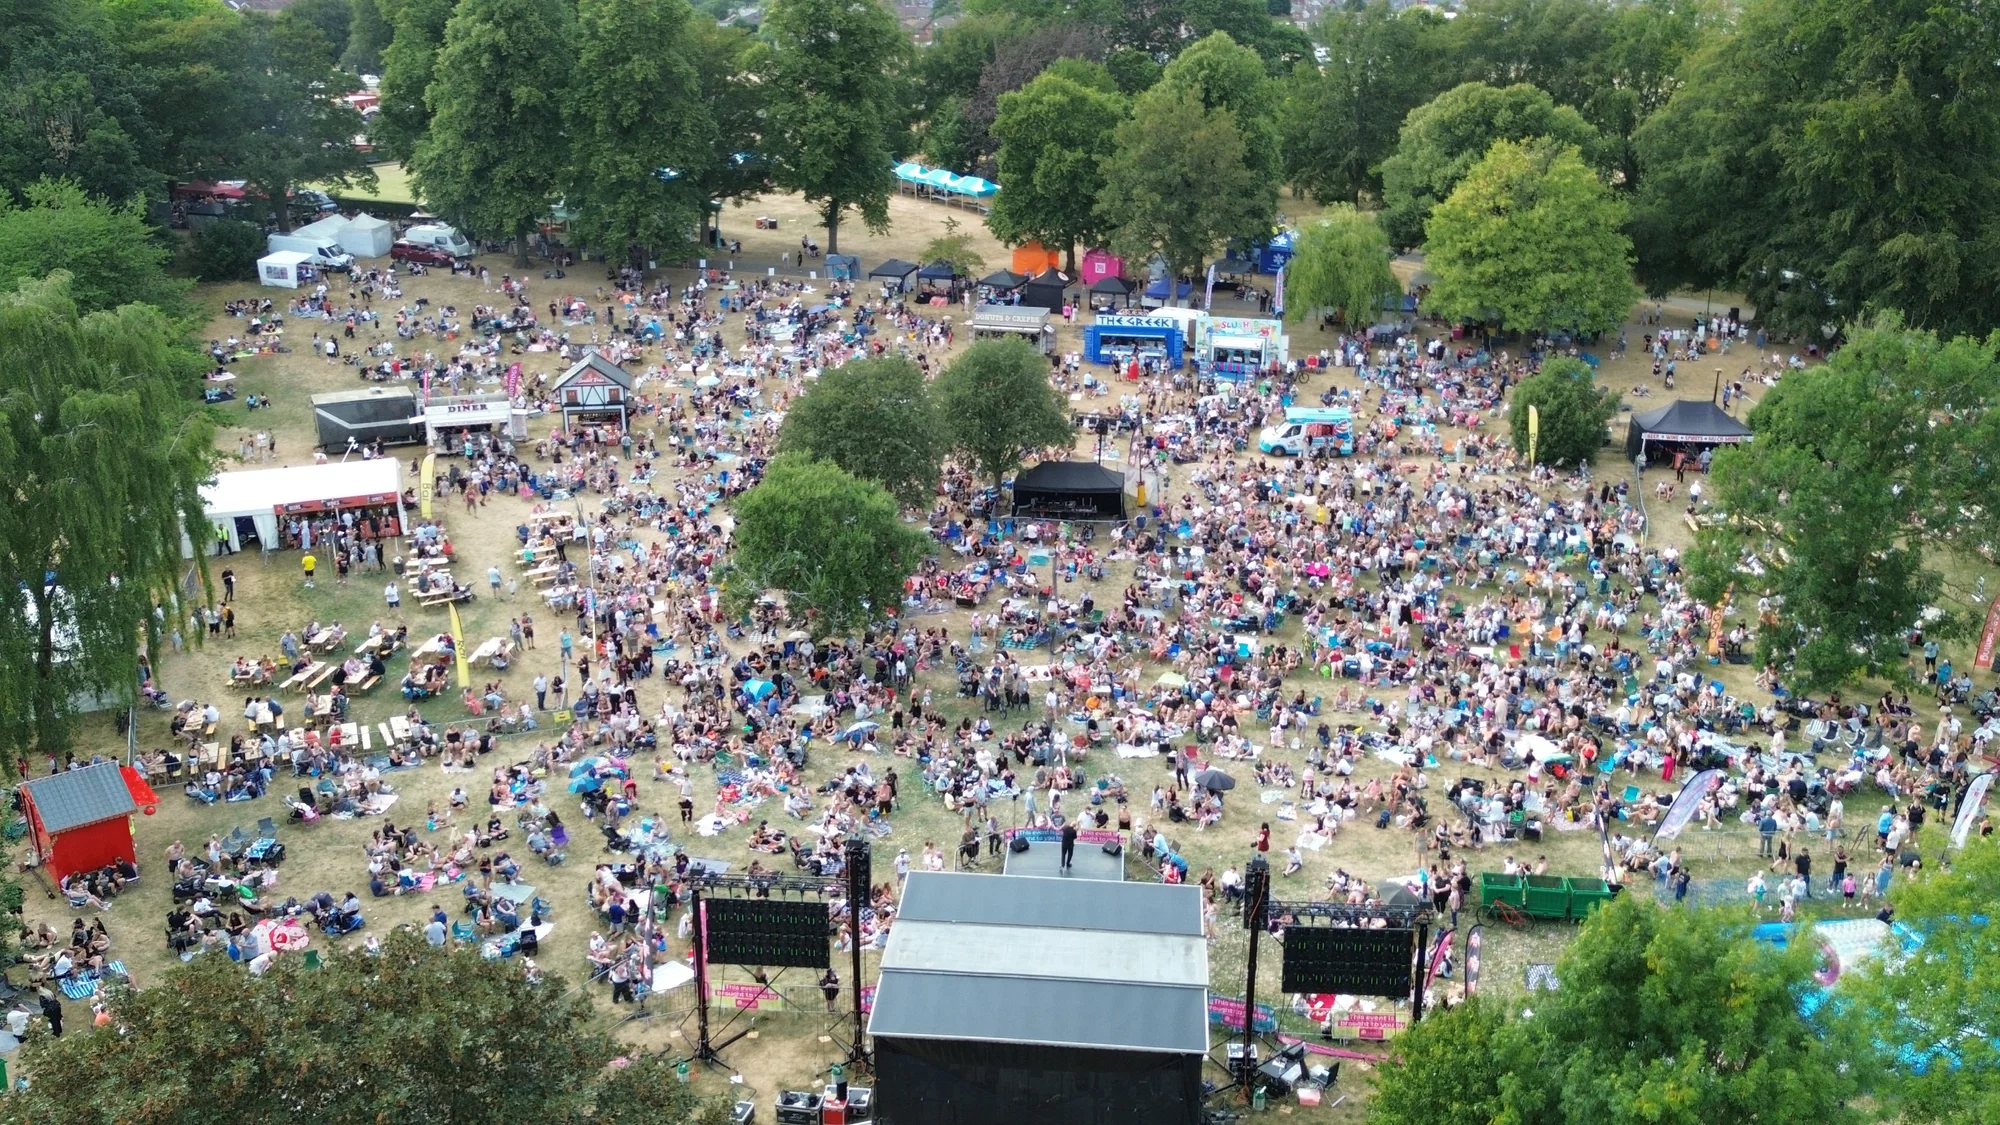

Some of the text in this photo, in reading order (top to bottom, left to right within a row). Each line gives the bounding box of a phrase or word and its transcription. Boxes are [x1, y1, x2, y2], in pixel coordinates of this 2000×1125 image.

[975, 313, 1004, 322] DONUTS
[1012, 315, 1040, 323] CREPES
[1100, 316, 1170, 327] THE GREEK
[508, 365, 518, 398] HOTDOGS
[448, 404, 488, 413] DINER
[422, 483, 432, 501] Bar
